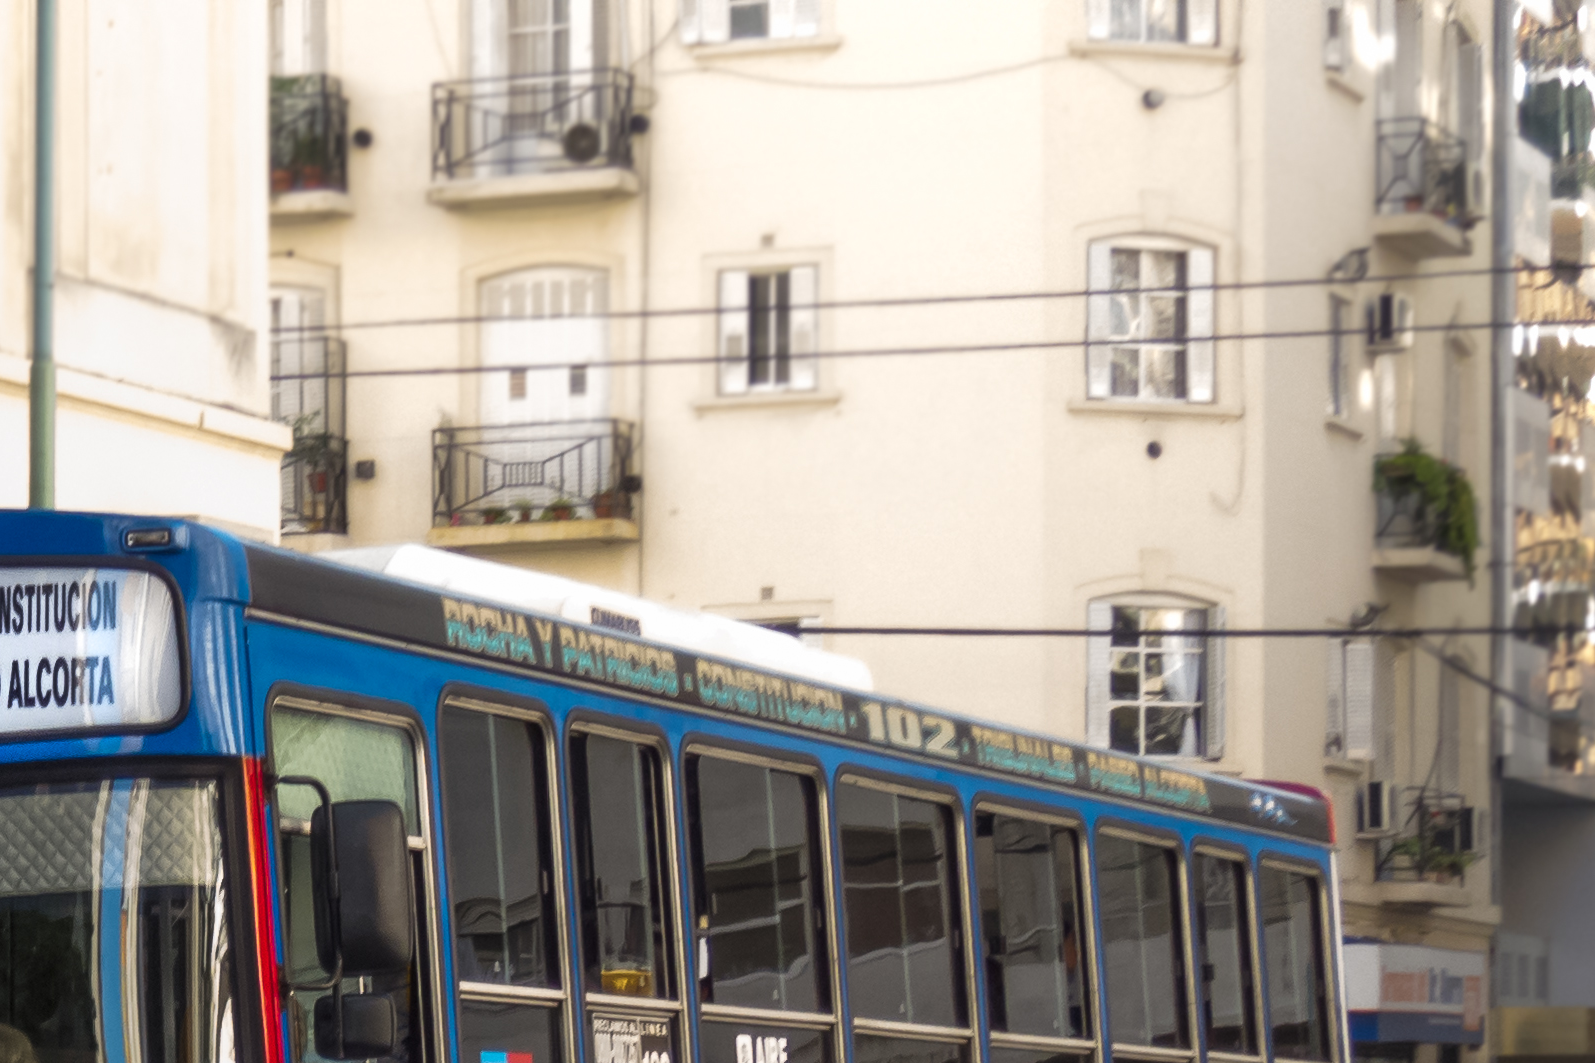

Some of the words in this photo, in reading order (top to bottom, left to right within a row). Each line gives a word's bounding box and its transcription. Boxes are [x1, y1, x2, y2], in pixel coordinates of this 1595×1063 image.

[5, 654, 116, 711] ALCORTA
[441, 596, 537, 666] ROCHA
[532, 617, 554, 669] Y
[859, 699, 961, 761] 102
